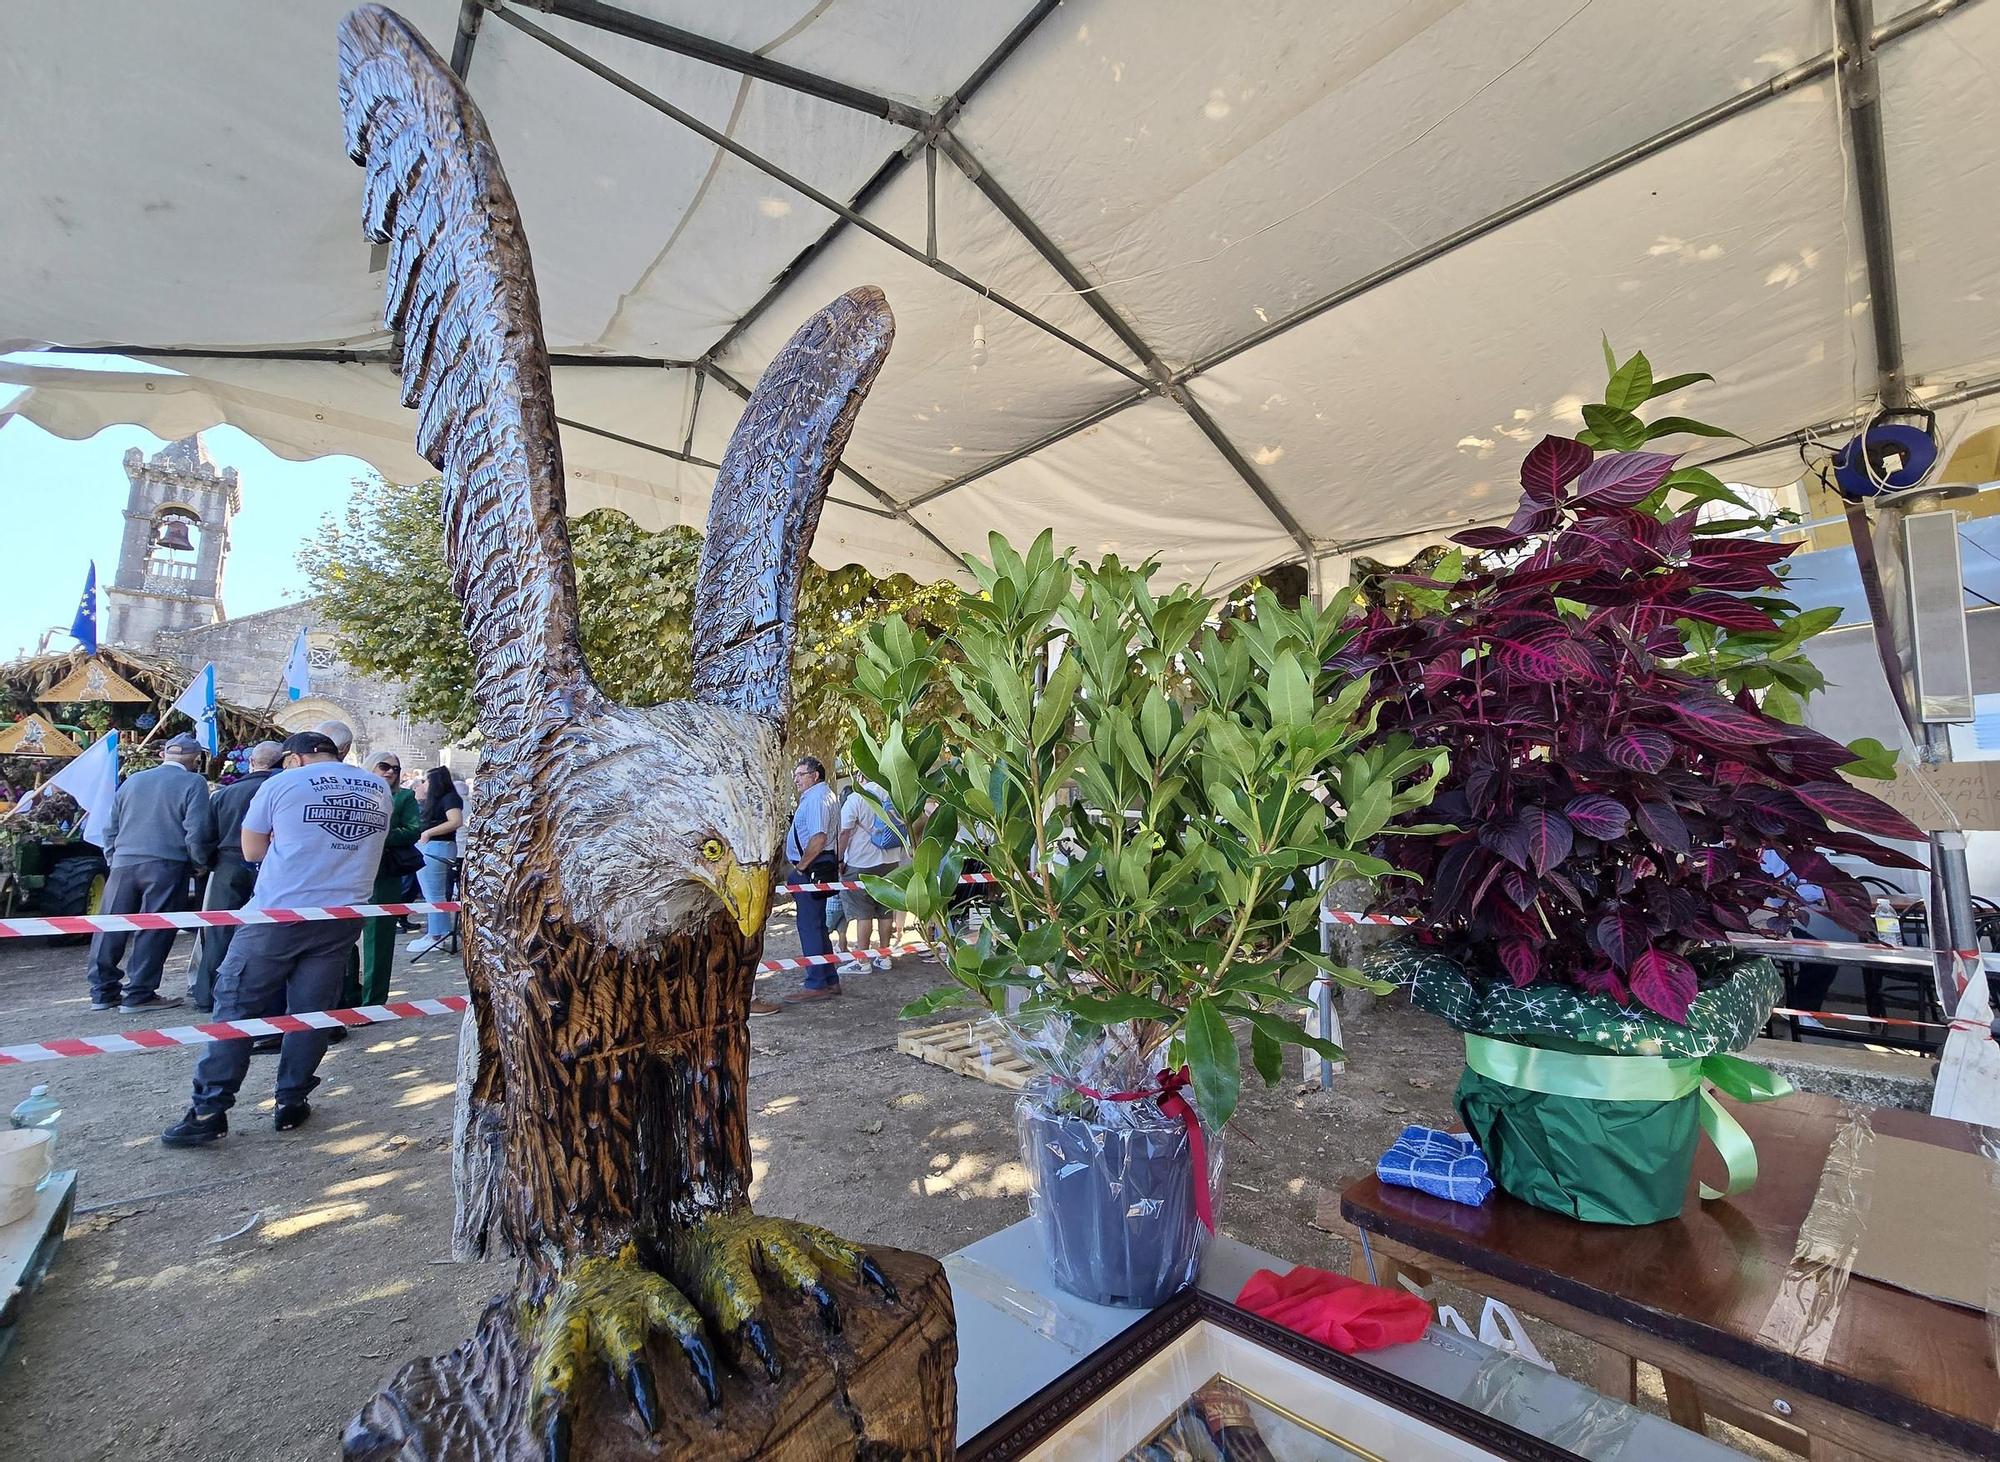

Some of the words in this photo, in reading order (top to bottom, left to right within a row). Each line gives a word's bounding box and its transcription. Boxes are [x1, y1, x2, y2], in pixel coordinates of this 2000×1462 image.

[308, 776, 338, 787] LAS
[342, 777, 384, 794] VEGAS
[1875, 775, 1984, 789] MOLSTAR
[333, 798, 374, 810] MOTOR
[311, 808, 385, 826] HARLEY-DAVIDSON
[331, 822, 369, 837] CYCLES
